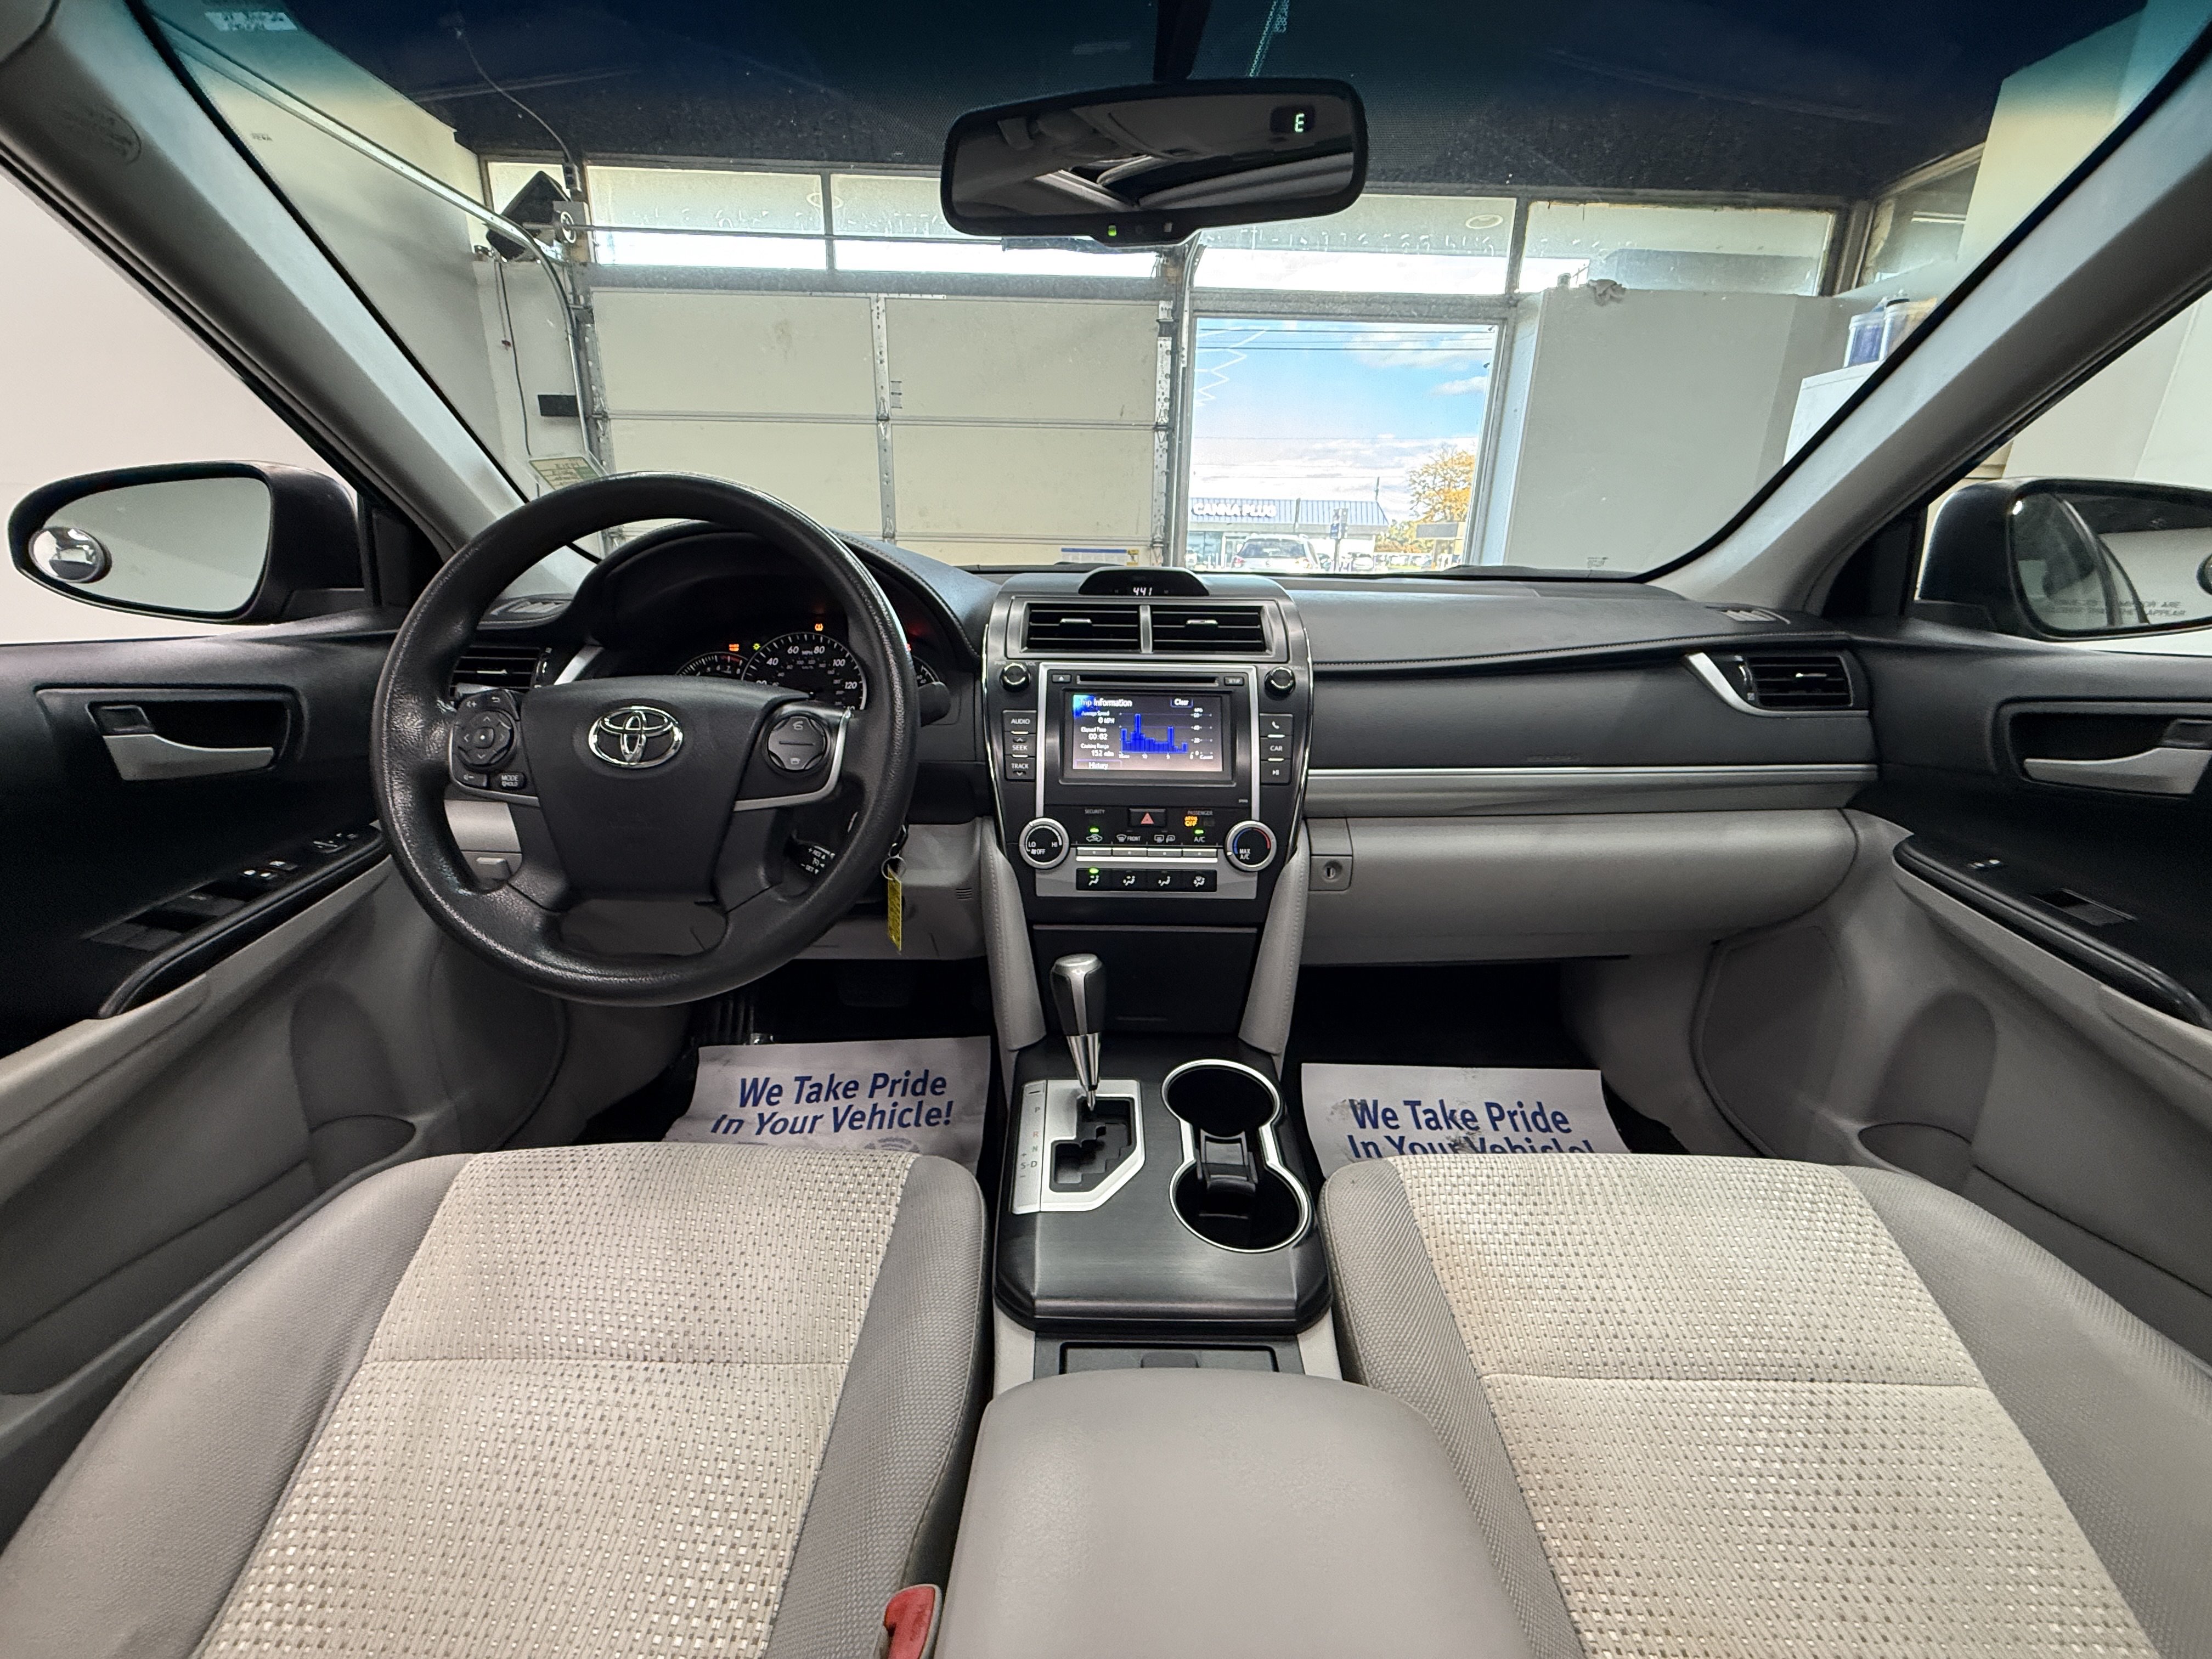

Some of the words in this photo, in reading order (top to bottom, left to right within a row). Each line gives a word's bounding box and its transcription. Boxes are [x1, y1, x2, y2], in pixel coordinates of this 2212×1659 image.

[1295, 113, 1305, 132] E
[1192, 503, 1241, 517] CANNA
[787, 646, 799, 654] 60
[814, 646, 825, 654] 80
[1093, 698, 1132, 707] Information
[739, 1077, 783, 1108] We
[793, 1073, 859, 1104] Take
[868, 1069, 947, 1098] Pride
[710, 1114, 744, 1135] In
[754, 1110, 825, 1136] Your
[832, 1101, 955, 1133] Vehicle!
[1347, 1099, 1400, 1130] We
[1403, 1099, 1480, 1131] Take
[1483, 1101, 1573, 1133] Pride
[1347, 1135, 1383, 1159] In
[1384, 1135, 1460, 1155] Your
